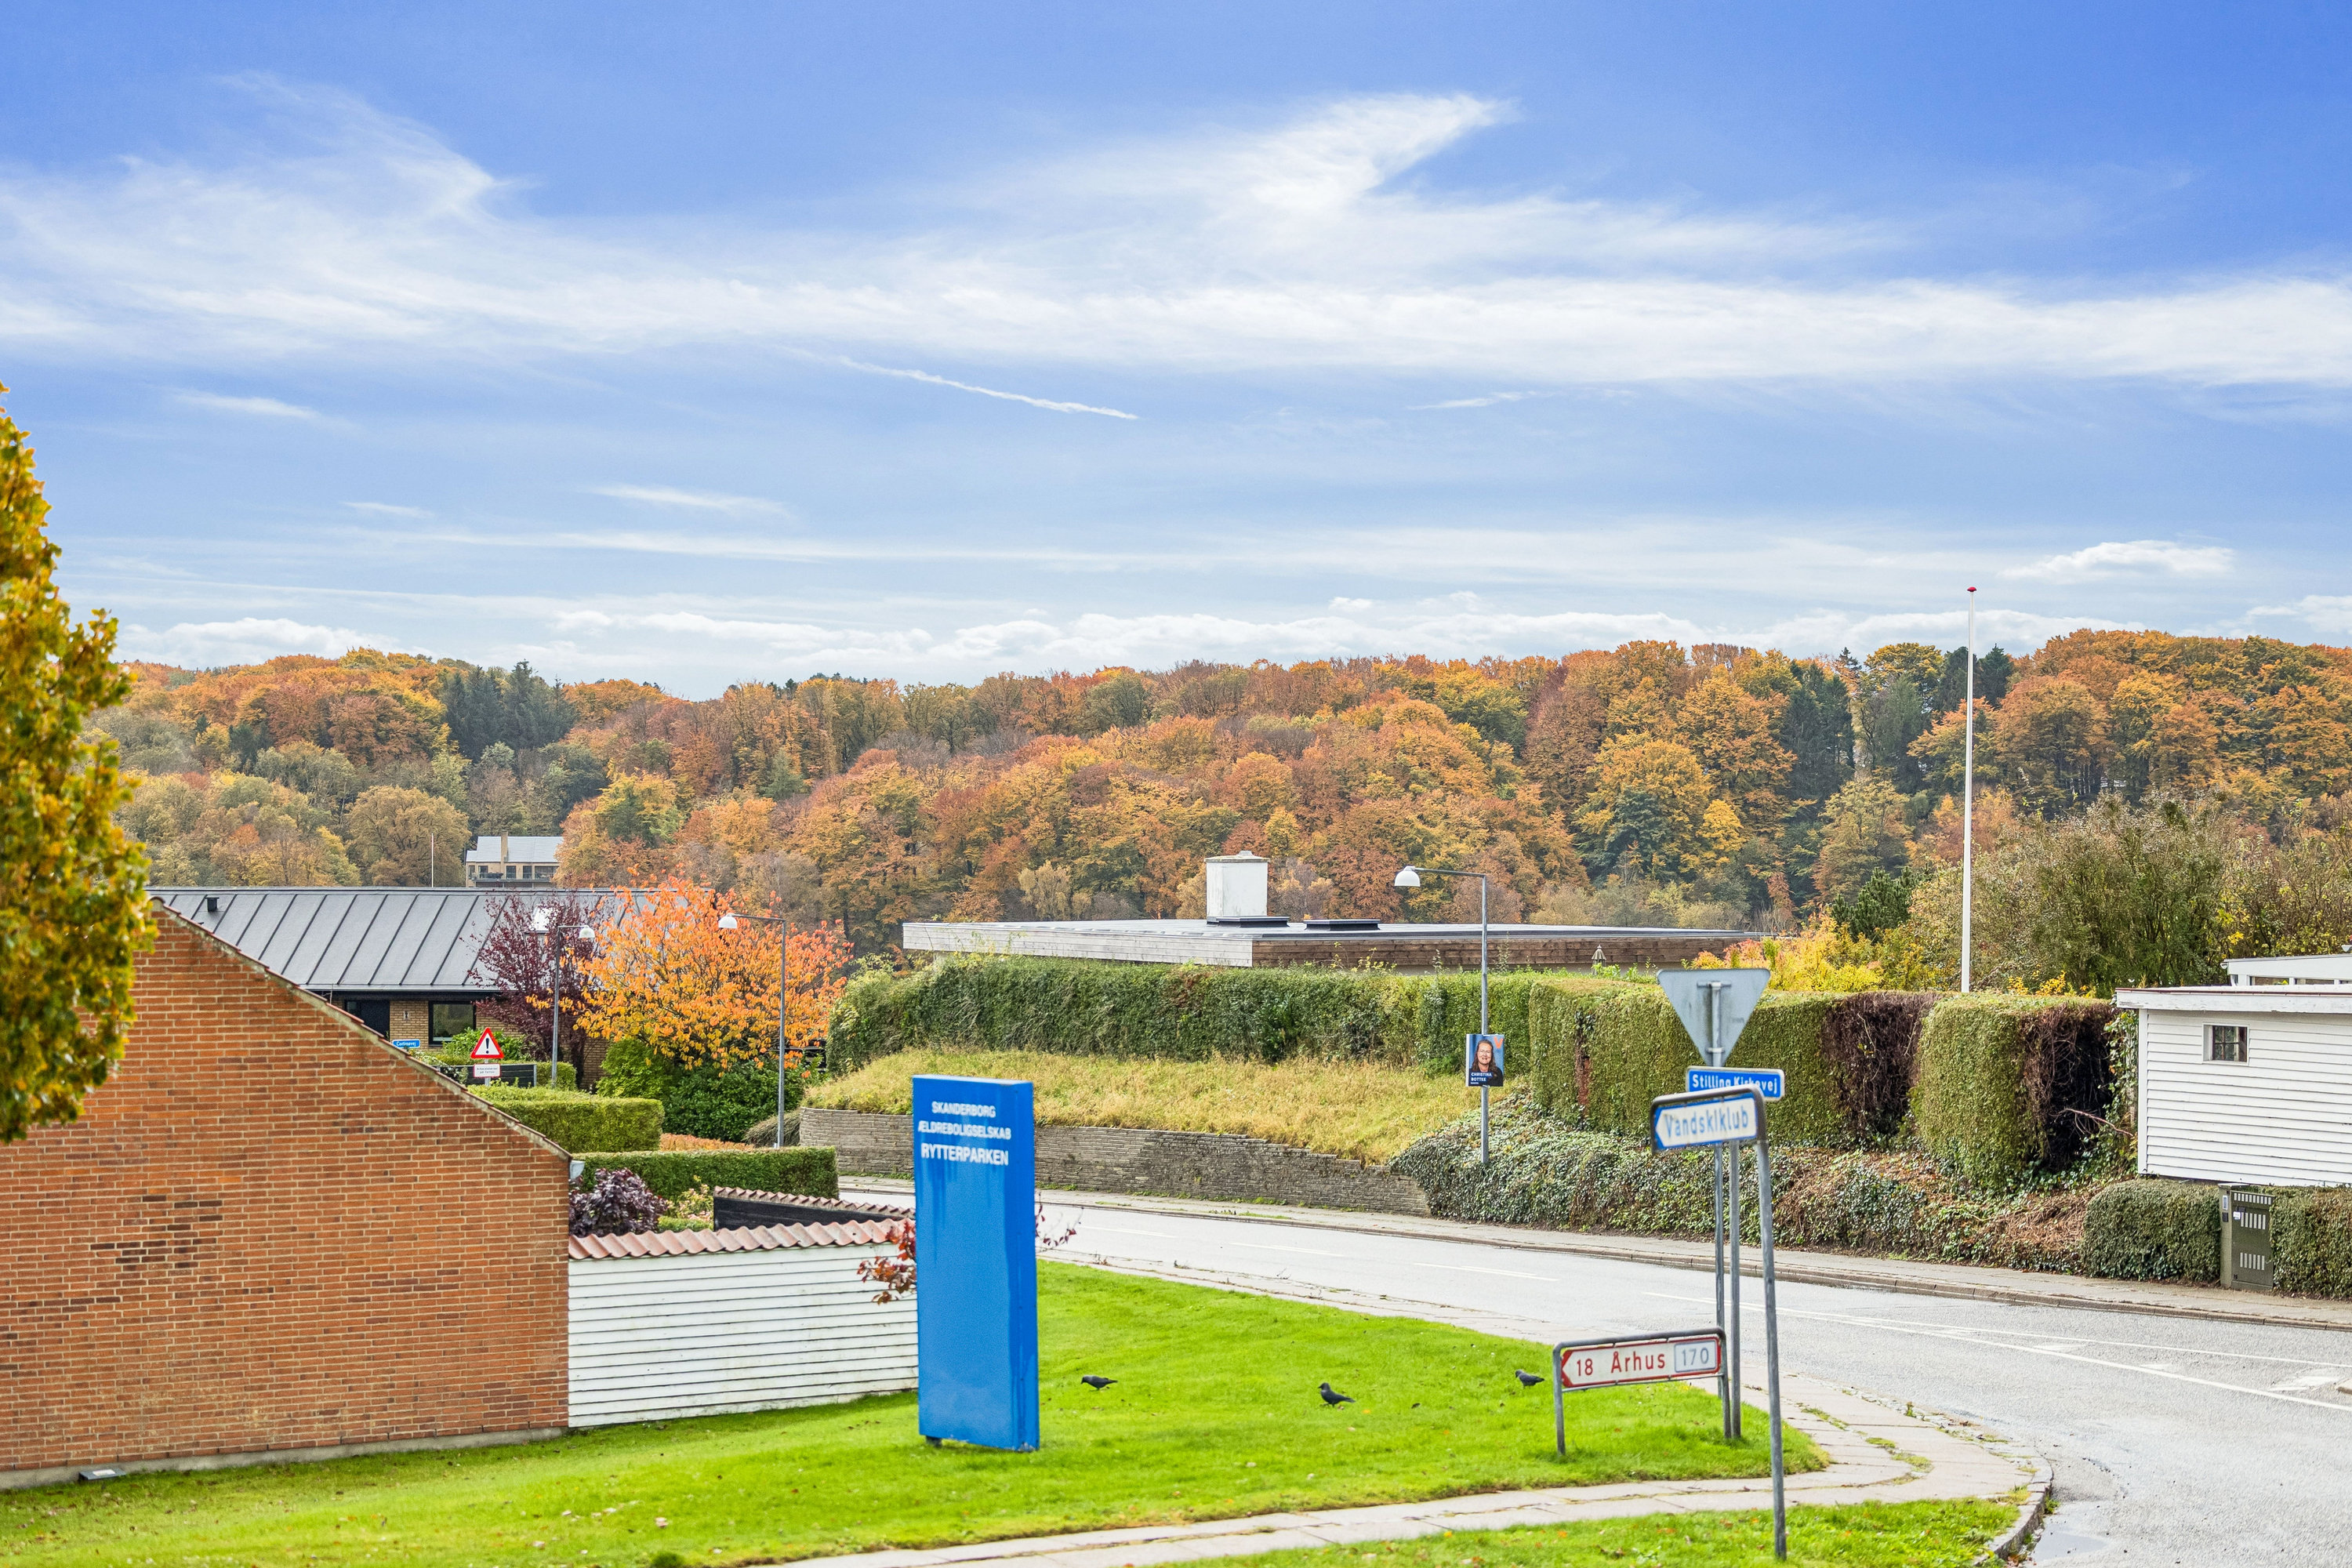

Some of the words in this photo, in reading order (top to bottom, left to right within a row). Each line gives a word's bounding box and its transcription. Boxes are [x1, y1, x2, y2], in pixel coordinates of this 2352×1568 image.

[1494, 1036, 1504, 1049] V
[1693, 1073, 1731, 1088] Stilling
[931, 1101, 996, 1118] SKANDERBORG
[918, 1120, 1012, 1140] ÆLDREBOLIGSELSKAB
[920, 1142, 1009, 1166] RYTTERPARKEN
[1577, 1358, 1594, 1377] 18
[1610, 1351, 1665, 1374] Århus
[1682, 1347, 1709, 1366] 170
